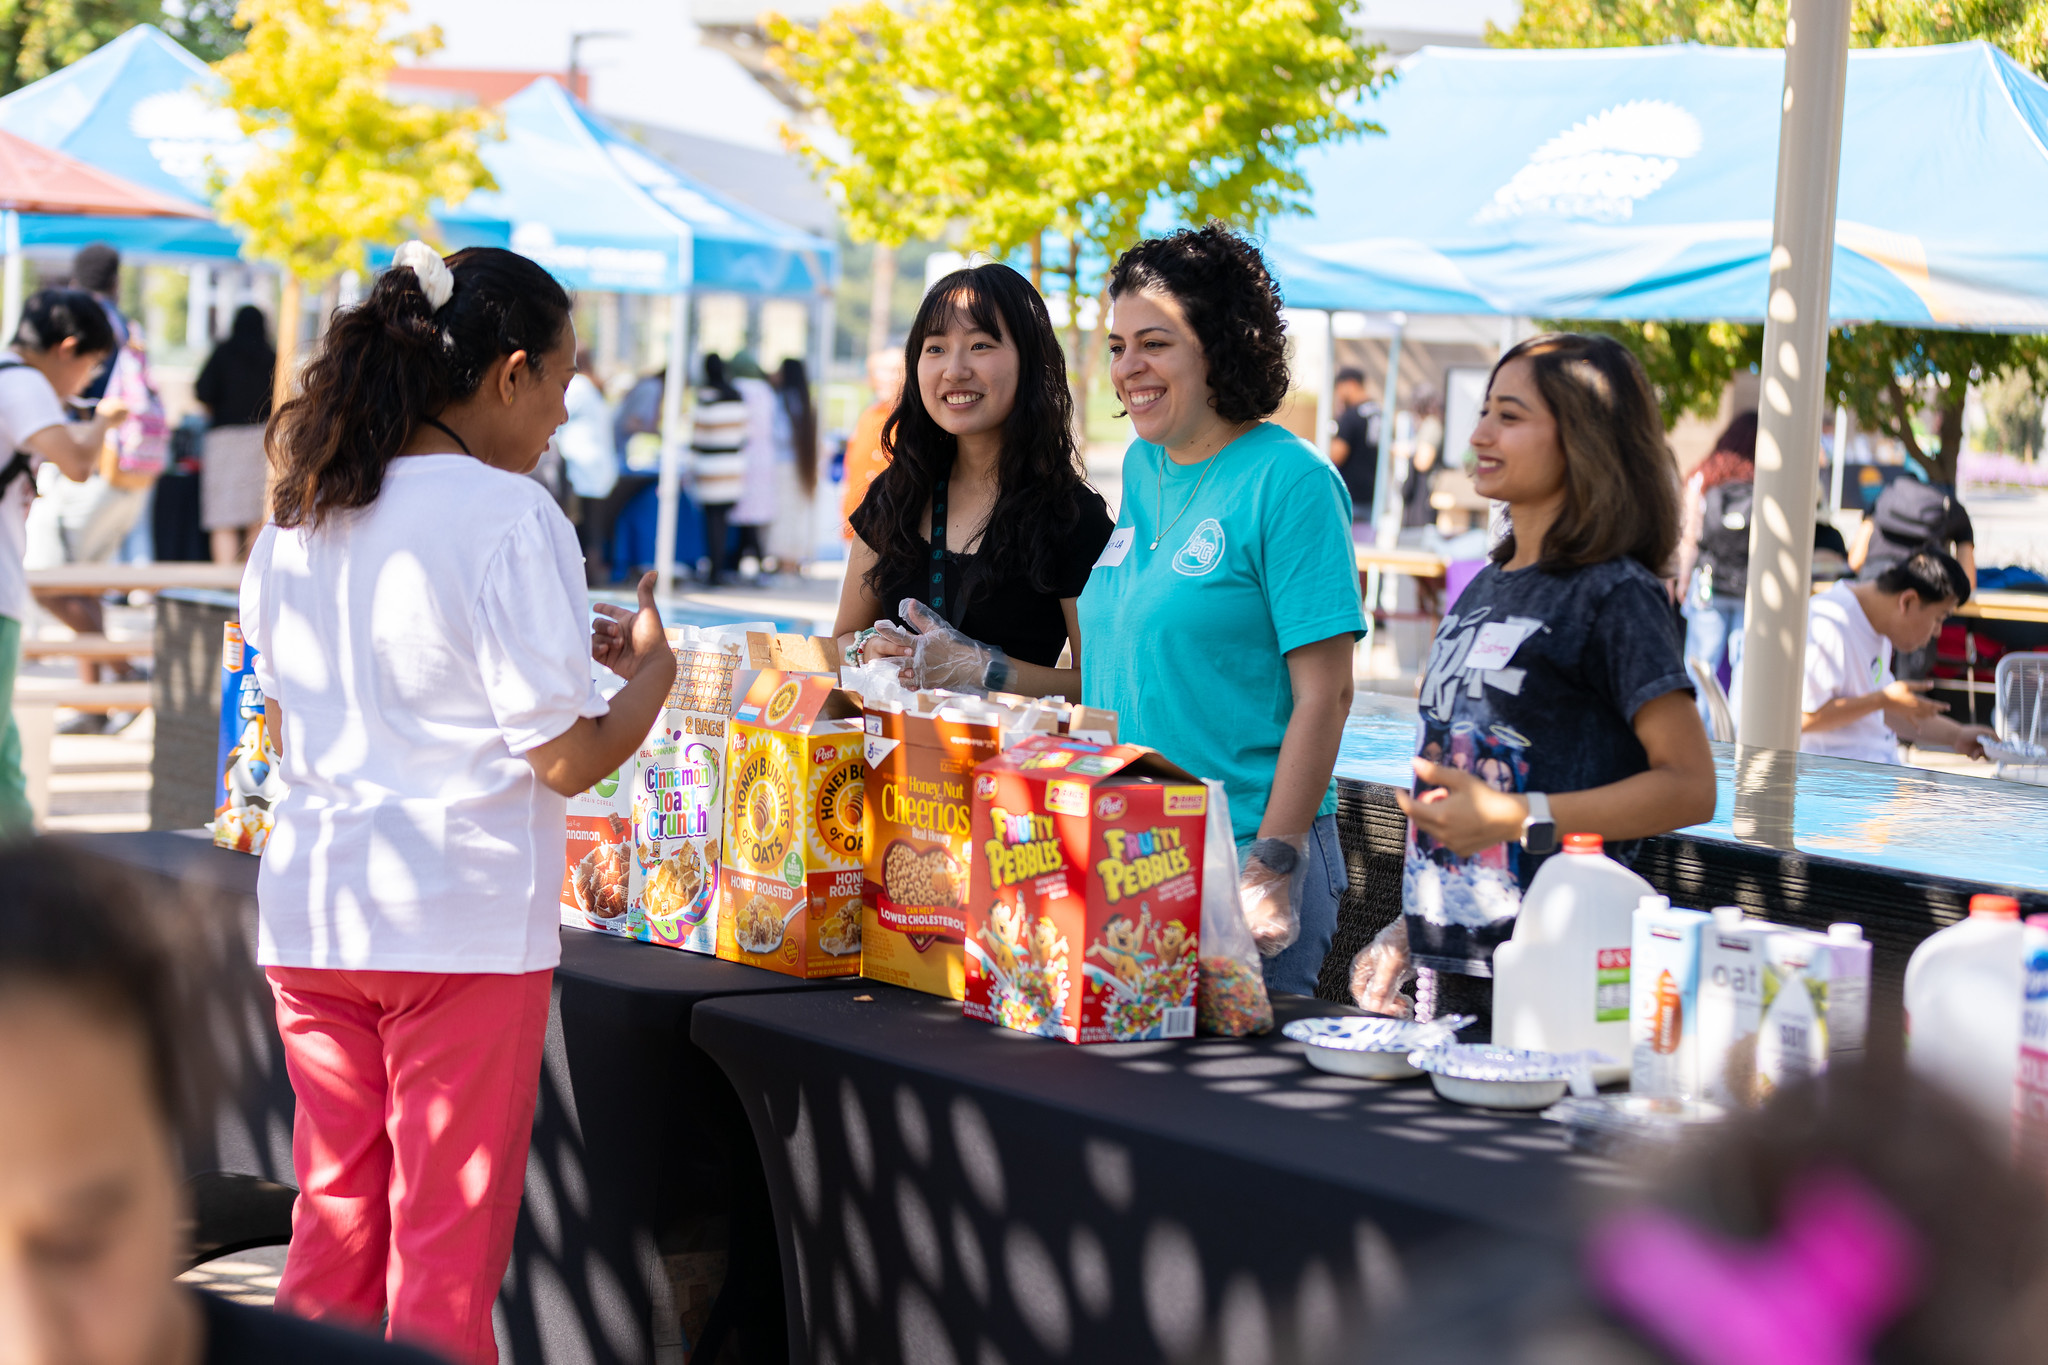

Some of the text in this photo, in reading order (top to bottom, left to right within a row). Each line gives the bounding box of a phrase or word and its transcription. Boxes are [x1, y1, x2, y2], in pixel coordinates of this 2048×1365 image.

[685, 716, 725, 738] 2 BAGS!
[640, 746, 680, 758] REAL CINNAMON
[732, 734, 746, 750] Post
[815, 747, 834, 763] Post
[647, 765, 709, 790] Cinnamon
[908, 776, 940, 800] Honey
[943, 781, 964, 800] Nut
[977, 776, 997, 795] Post
[657, 786, 697, 813] Toast
[738, 757, 790, 830] HONEY BUNCHES
[821, 768, 847, 821] HONEY
[1049, 787, 1060, 803] 2
[1168, 795, 1179, 810] 2
[881, 783, 971, 836] Cheerios
[1098, 797, 1123, 817] Post
[649, 804, 707, 838] Crunch
[567, 829, 600, 842] nnamon
[912, 826, 952, 848] Real Honey
[751, 836, 783, 865] OATS
[984, 838, 1064, 890] PEBBLES
[1096, 845, 1191, 905] PEBBLES
[731, 875, 793, 900] HONEY ROASTED
[829, 883, 863, 898] ROAS
[836, 872, 863, 886] HON
[880, 907, 907, 925] LOWER
[908, 915, 966, 932] CHOLESTEROL
[905, 906, 935, 915] CAN HELP
[1712, 966, 1758, 995] oat
